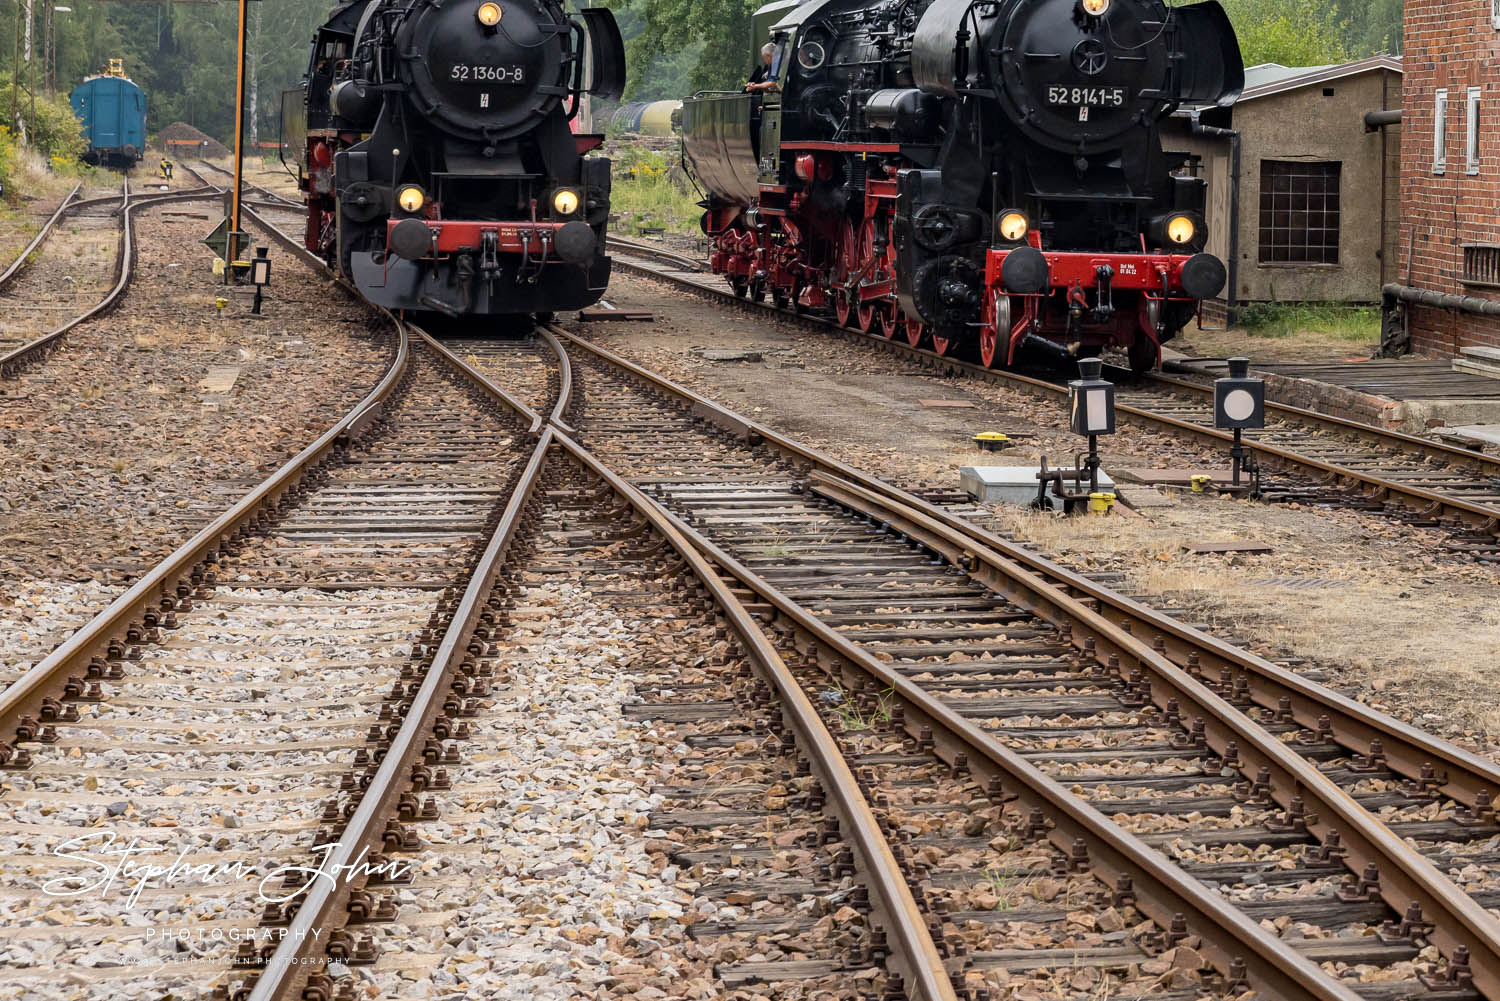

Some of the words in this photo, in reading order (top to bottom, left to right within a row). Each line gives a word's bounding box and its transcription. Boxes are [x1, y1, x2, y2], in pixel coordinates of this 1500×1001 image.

[451, 66, 468, 79] 52
[473, 66, 522, 80] 1360-8
[1049, 88, 1067, 104] 52
[1071, 88, 1122, 105] 8141-5
